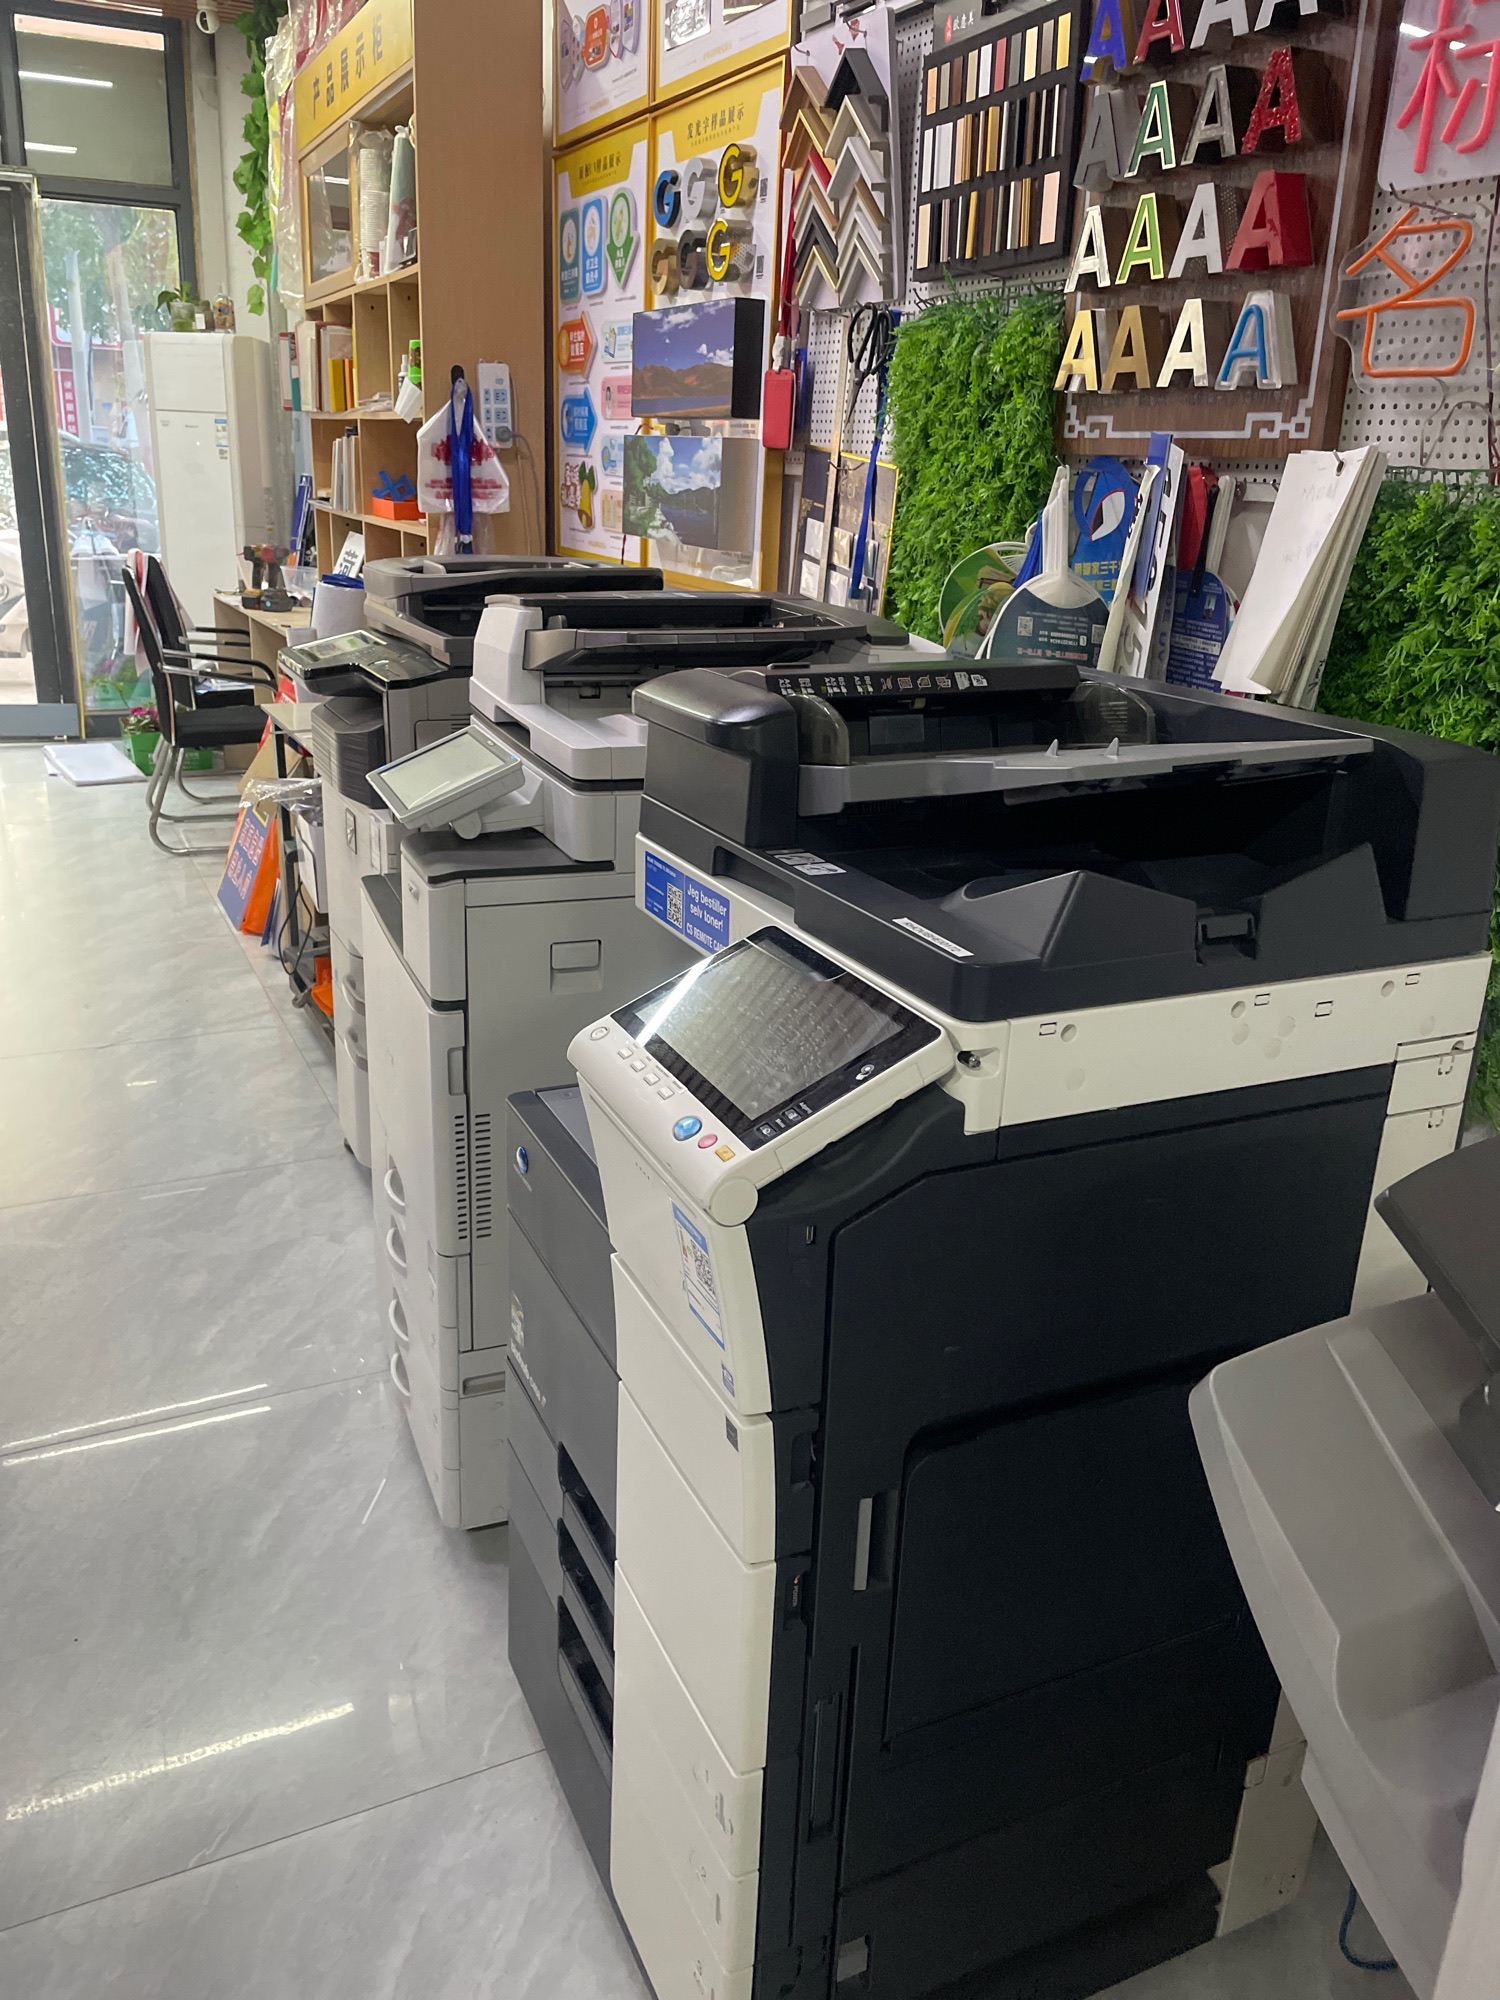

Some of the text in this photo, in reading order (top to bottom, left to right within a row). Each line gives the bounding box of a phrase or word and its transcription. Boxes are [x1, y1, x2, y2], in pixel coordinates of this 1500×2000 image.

[313, 11, 383, 120] 产品展示柜
[1080, 0, 1127, 82] A
[686, 102, 745, 140] 发光字样品展示
[1074, 45, 1301, 188] A A A A
[653, 143, 744, 228] G G G
[706, 218, 731, 281] G
[1064, 170, 1284, 293] A A A A
[1337, 206, 1474, 378] 名
[1053, 295, 1281, 394] A A A A
[686, 922, 727, 952] CS REMOTE CAR
[687, 883, 699, 903] Jeg
[700, 890, 727, 917] bestiller
[690, 903, 724, 932] selv toner!
